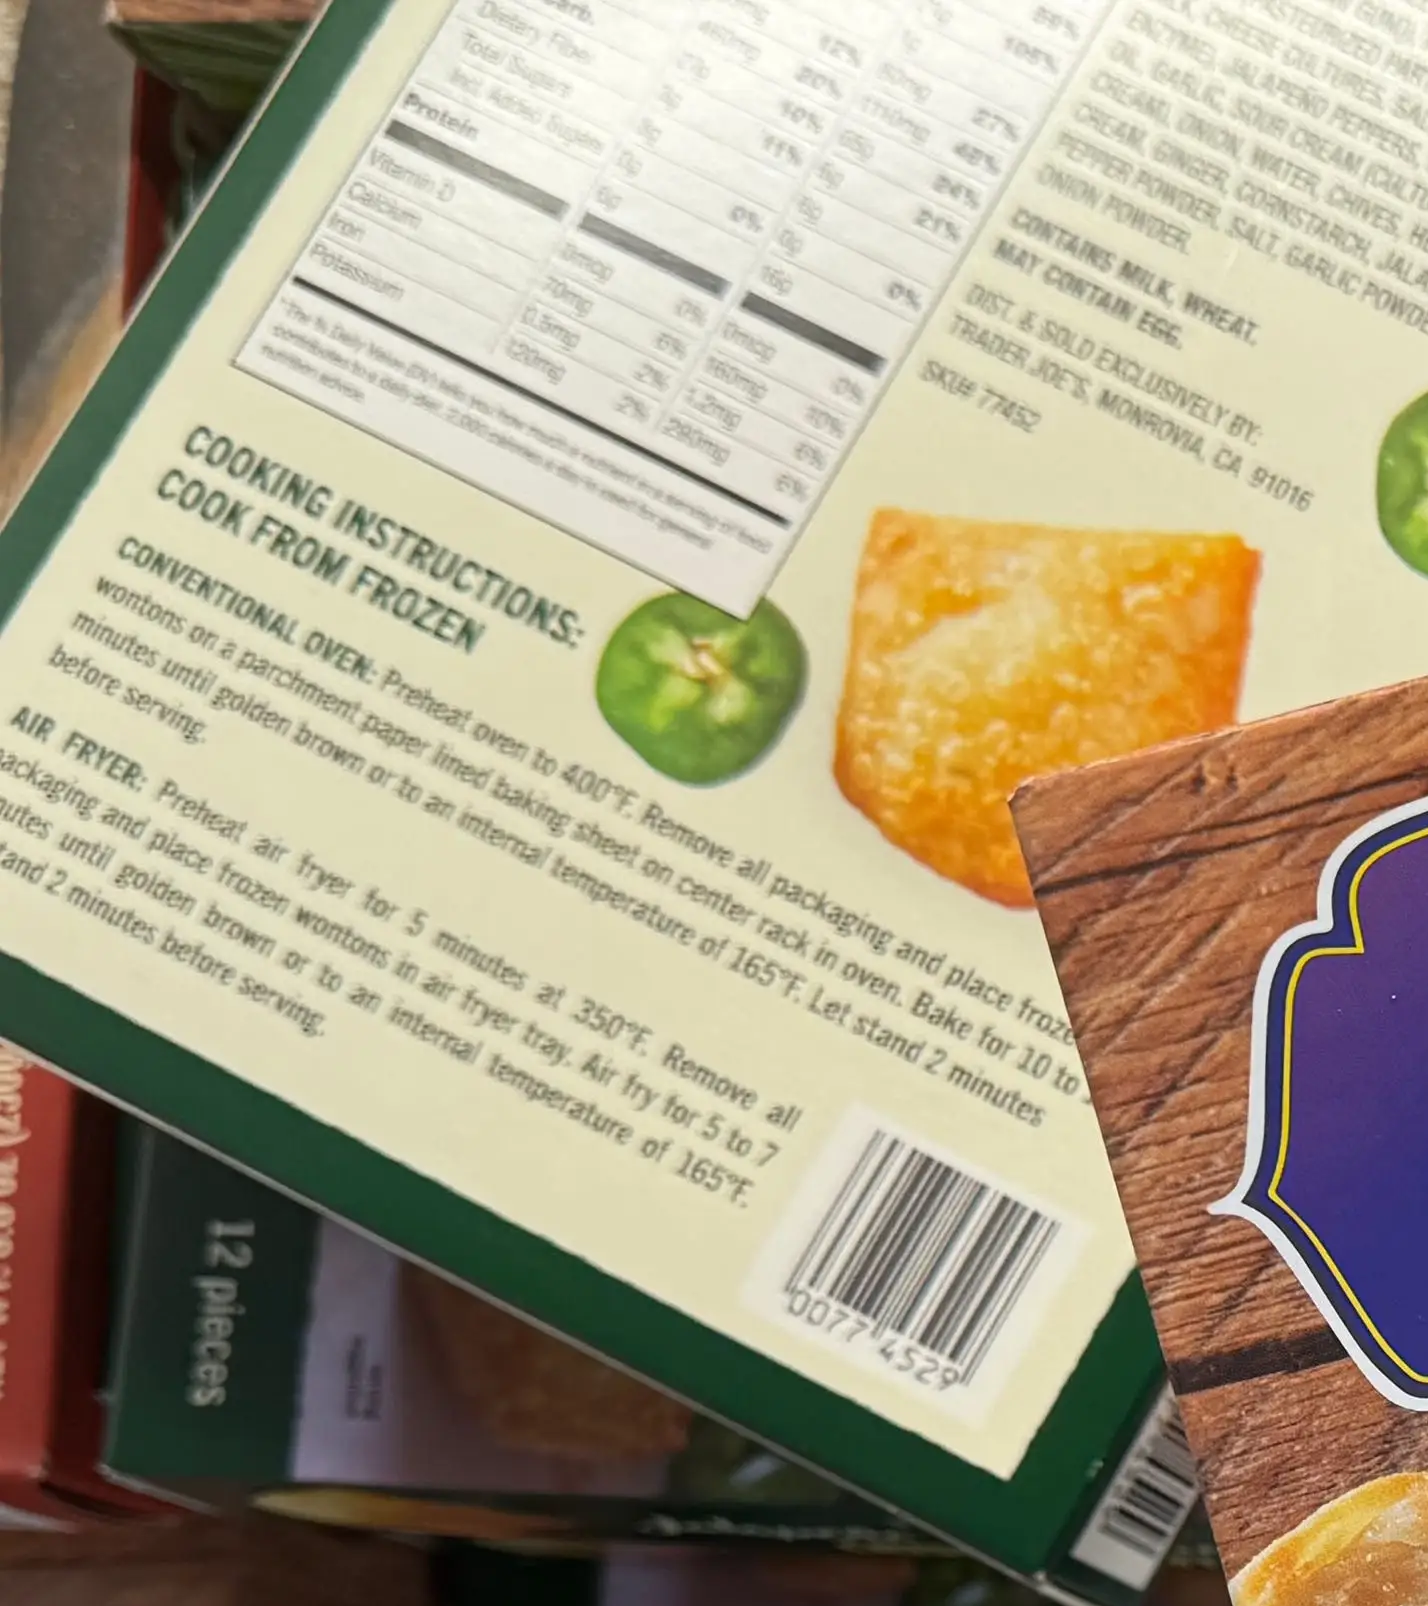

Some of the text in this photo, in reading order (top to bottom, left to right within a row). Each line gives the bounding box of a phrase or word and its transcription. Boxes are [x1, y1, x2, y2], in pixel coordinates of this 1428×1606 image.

[993, 238, 1043, 272] MAY
[1042, 263, 1136, 321] CONTAIN
[1011, 208, 1116, 271] CONTAINS
[1183, 291, 1259, 345] WHEAT.
[183, 425, 583, 648] COOKING INSTRUCTIONS:
[1096, 388, 1204, 461] MONROVIA,
[1212, 443, 1242, 477] CA
[1248, 466, 1314, 511] 91016
[156, 468, 485, 653] COOK FROM FROZEN
[47, 643, 206, 744] before serving.
[116, 536, 297, 644] CONVENTIONAL
[302, 630, 376, 683] OVEN:
[379, 668, 471, 731] Preheat
[471, 722, 529, 760] oven
[531, 748, 556, 775] to
[639, 802, 733, 867] Remove
[736, 859, 770, 884] all
[767, 875, 894, 955] packaging
[894, 941, 946, 974] and
[943, 965, 1013, 1011] place
[1016, 999, 1077, 1046] froze
[10, 704, 57, 744] AIR
[61, 729, 147, 792] FRYER:
[155, 778, 247, 842] Preheat
[252, 837, 289, 862] air
[296, 853, 354, 897] fryer
[361, 888, 399, 920] for
[404, 909, 427, 936] 5
[432, 930, 527, 990] minutes
[534, 985, 565, 1010] at
[661, 1043, 757, 1109] Remove
[765, 1105, 802, 1131] all
[71, 611, 159, 667] minutes
[160, 658, 217, 694] until
[209, 685, 292, 735] golden
[291, 721, 365, 773] brown
[365, 765, 398, 786] or
[393, 775, 422, 803] to
[422, 794, 456, 820] an
[456, 811, 552, 868] internal
[549, 855, 696, 945] temperature
[697, 936, 730, 959] of
[806, 985, 851, 1026] Let
[851, 1015, 926, 1063] stand
[923, 1047, 947, 1074] 2
[946, 1063, 1045, 1126] minutes
[95, 576, 1080, 1097] wontons on a parchment paper lined baking sheet on center rack in oven. Bake for 10 to
[0, 747, 779, 1166] ackaging and place frozen wontons in air fryer tray. Air fry for 5 to 7
[57, 832, 115, 871] until
[113, 862, 196, 915] golden
[201, 901, 276, 956] brown
[280, 950, 311, 973] or
[316, 964, 342, 992] to
[347, 984, 381, 1012] an
[387, 1006, 482, 1063] internal
[485, 1053, 633, 1144] temperature
[639, 1138, 672, 1161] of
[186, 1218, 256, 1407] 12 pieces
[786, 1289, 959, 1392] 0077 4529
